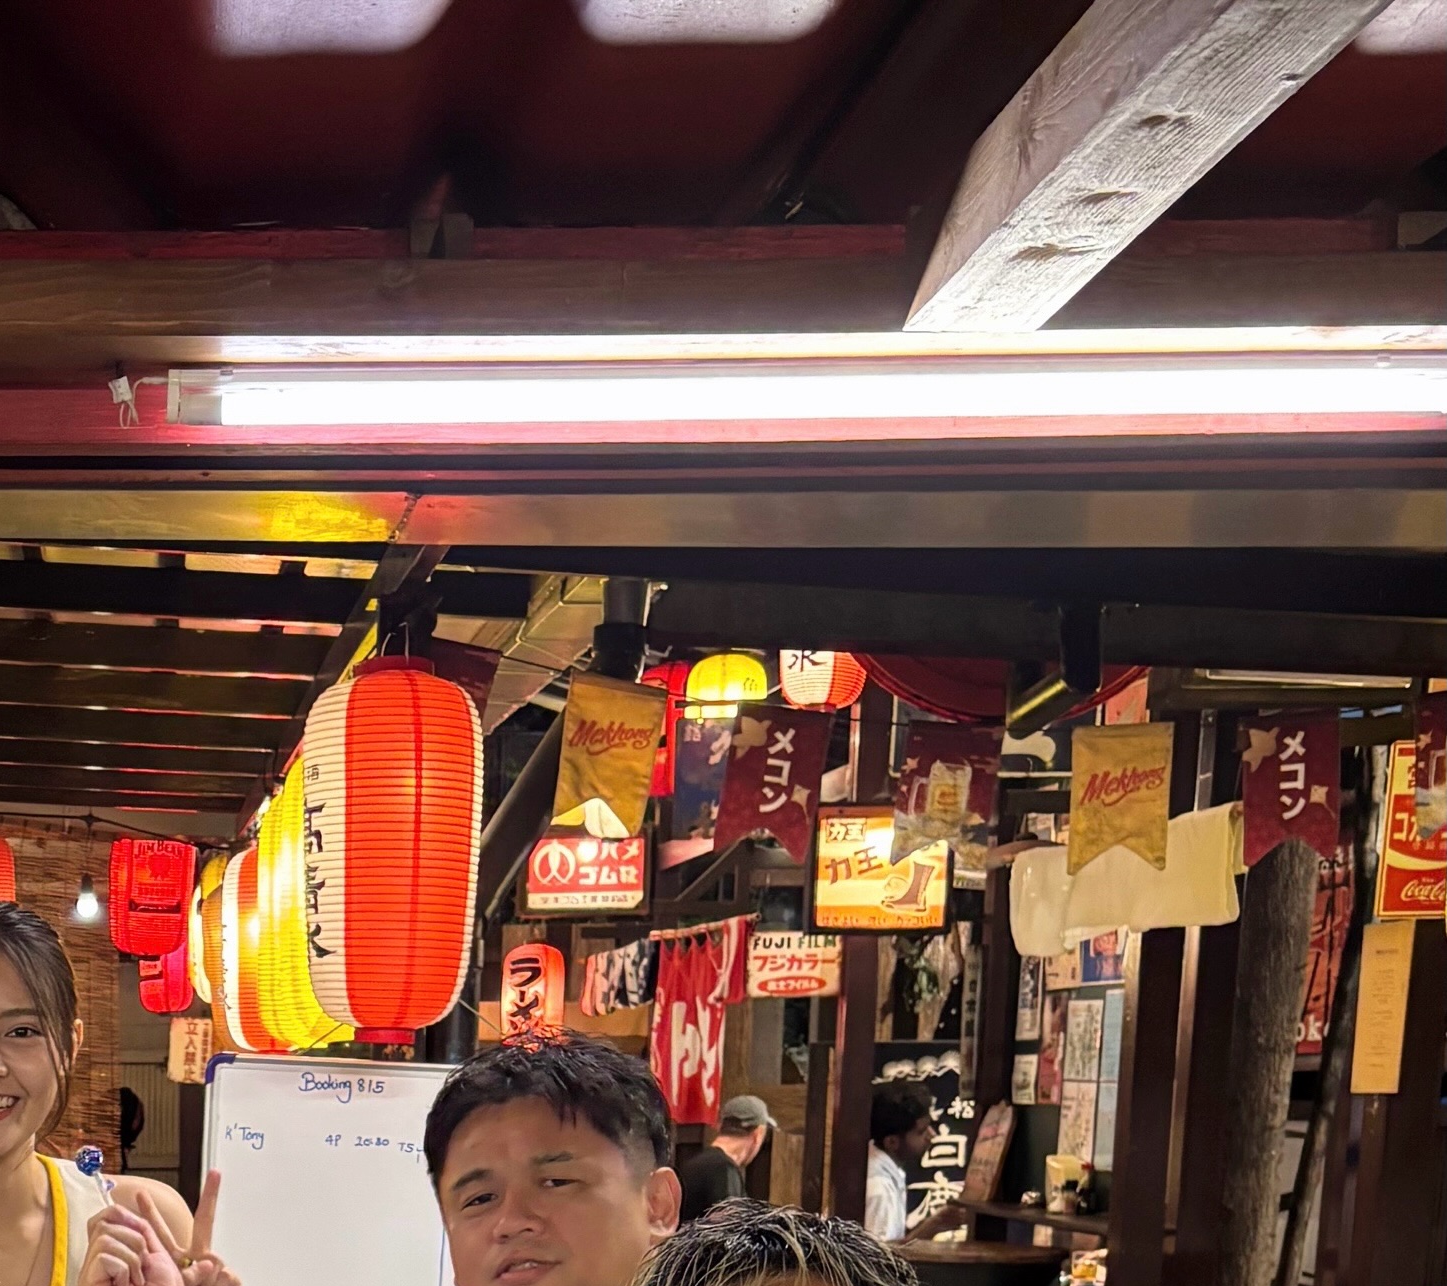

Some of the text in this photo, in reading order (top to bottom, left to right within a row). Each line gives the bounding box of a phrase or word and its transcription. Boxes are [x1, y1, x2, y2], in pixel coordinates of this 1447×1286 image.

[568, 719, 654, 756] Mekhong
[758, 727, 796, 814] メコン
[1079, 763, 1167, 807] Mekhong
[1278, 730, 1306, 821] メコン
[824, 846, 884, 886] 力王
[753, 934, 837, 951] FUJI FILM
[753, 953, 836, 973] フジカラー
[298, 1072, 352, 1104] Booking
